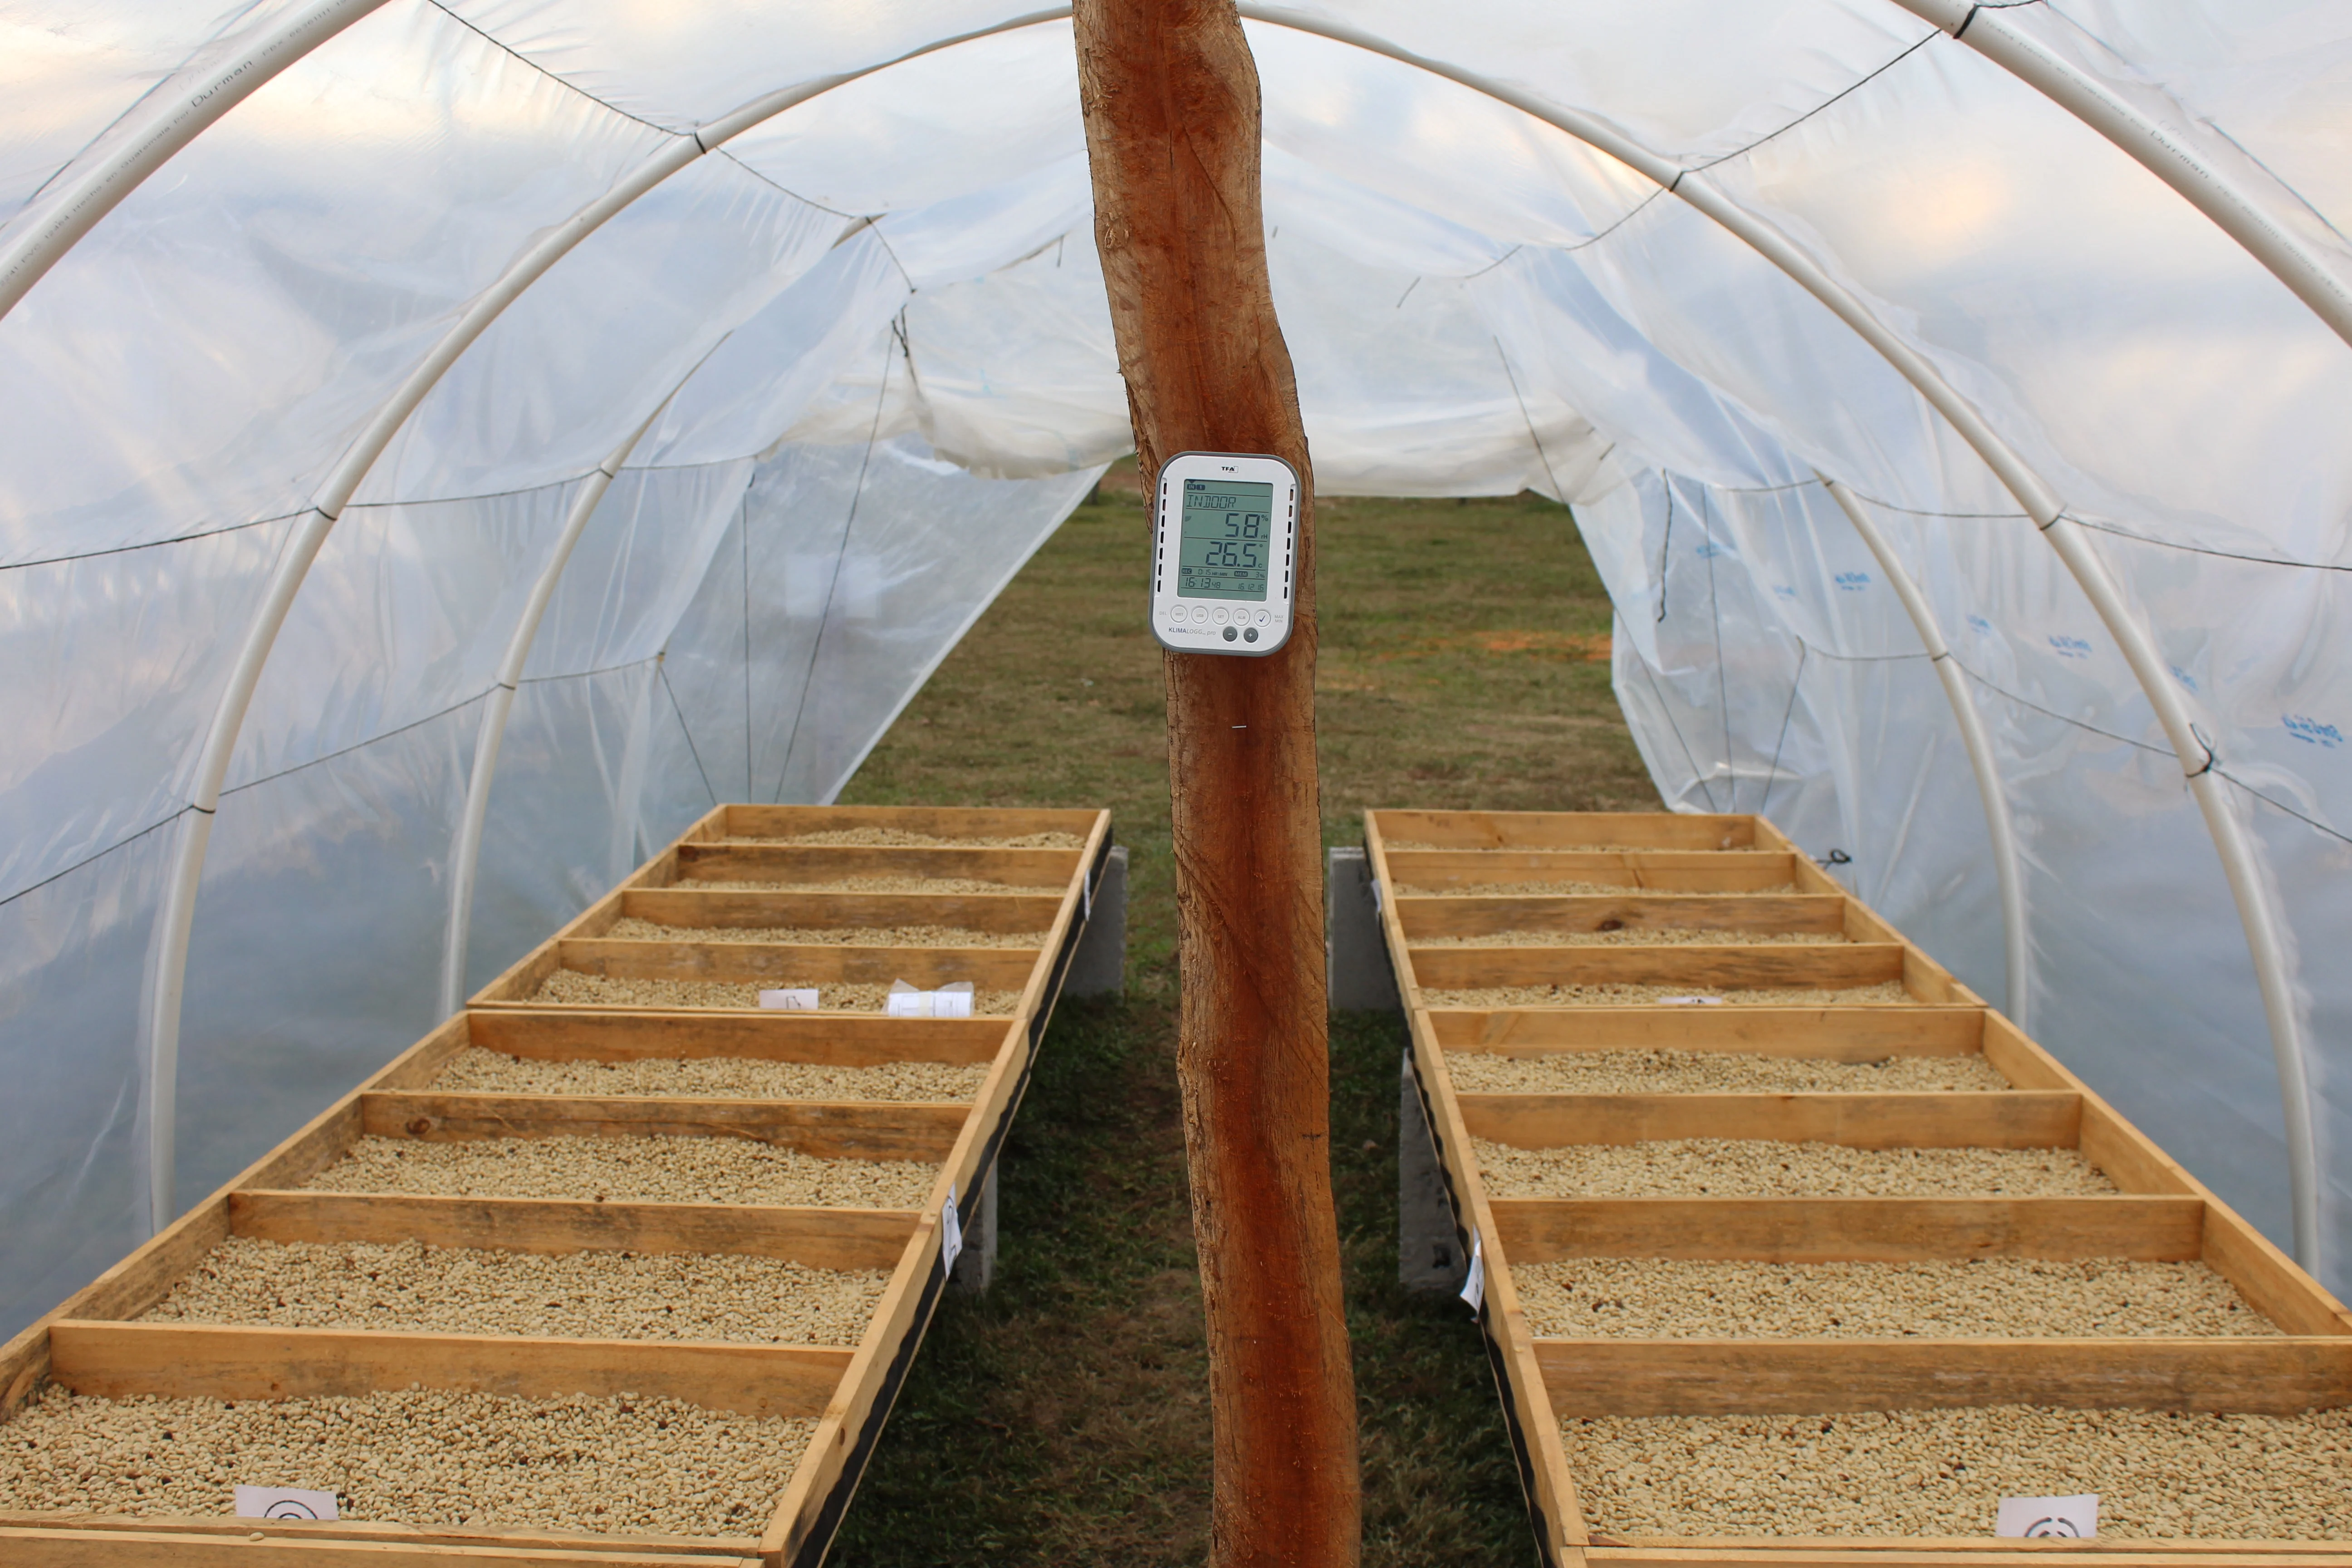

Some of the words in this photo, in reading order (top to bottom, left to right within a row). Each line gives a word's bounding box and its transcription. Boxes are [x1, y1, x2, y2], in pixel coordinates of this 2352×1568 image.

[73, 186, 102, 212] Hecho
[106, 172, 118, 183] en
[121, 126, 171, 169] Guatemala
[191, 60, 253, 108] Durman
[2150, 130, 2209, 179] Durman
[1186, 495, 1236, 509] INDOOR
[1225, 513, 1260, 539] 58
[1205, 541, 1257, 568] 26.5
